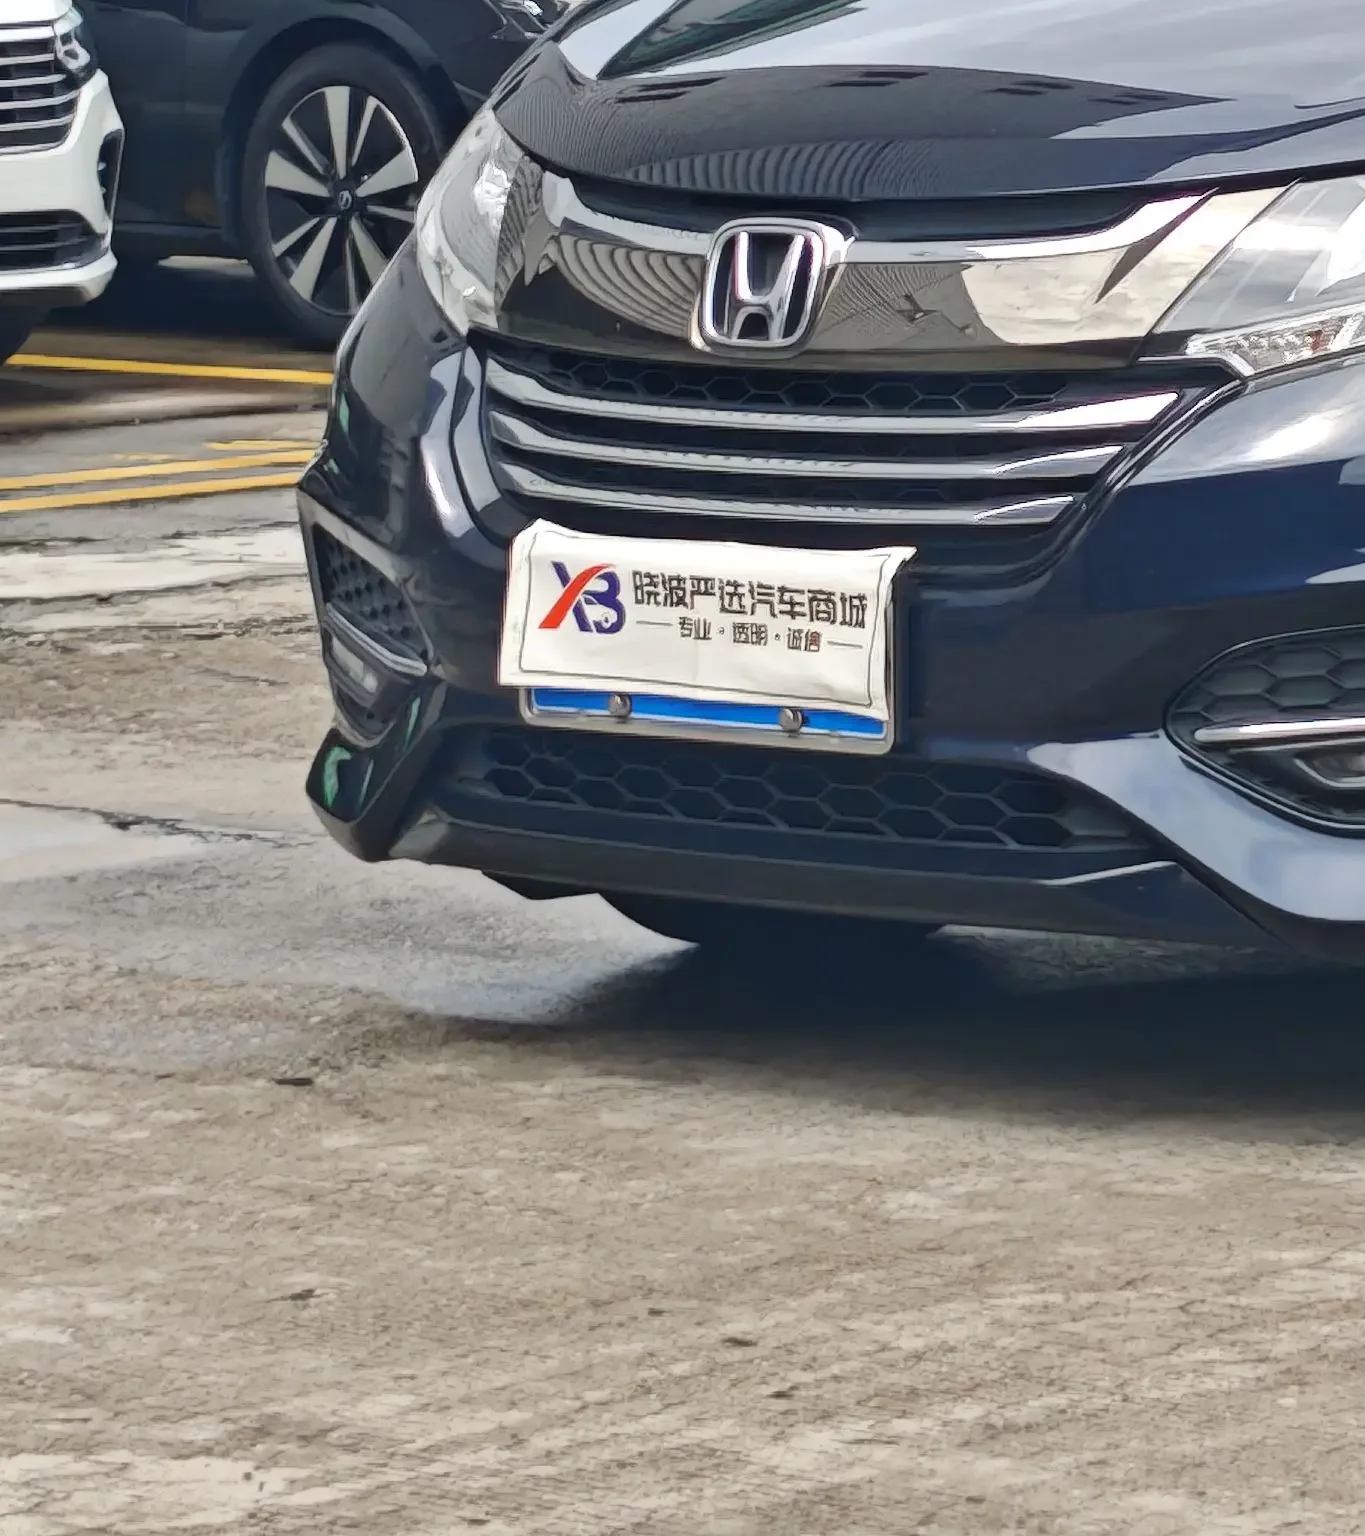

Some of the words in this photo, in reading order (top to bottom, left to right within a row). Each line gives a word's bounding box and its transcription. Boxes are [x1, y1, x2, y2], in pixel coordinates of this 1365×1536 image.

[632, 569, 868, 629] 晓波严选汽车商城
